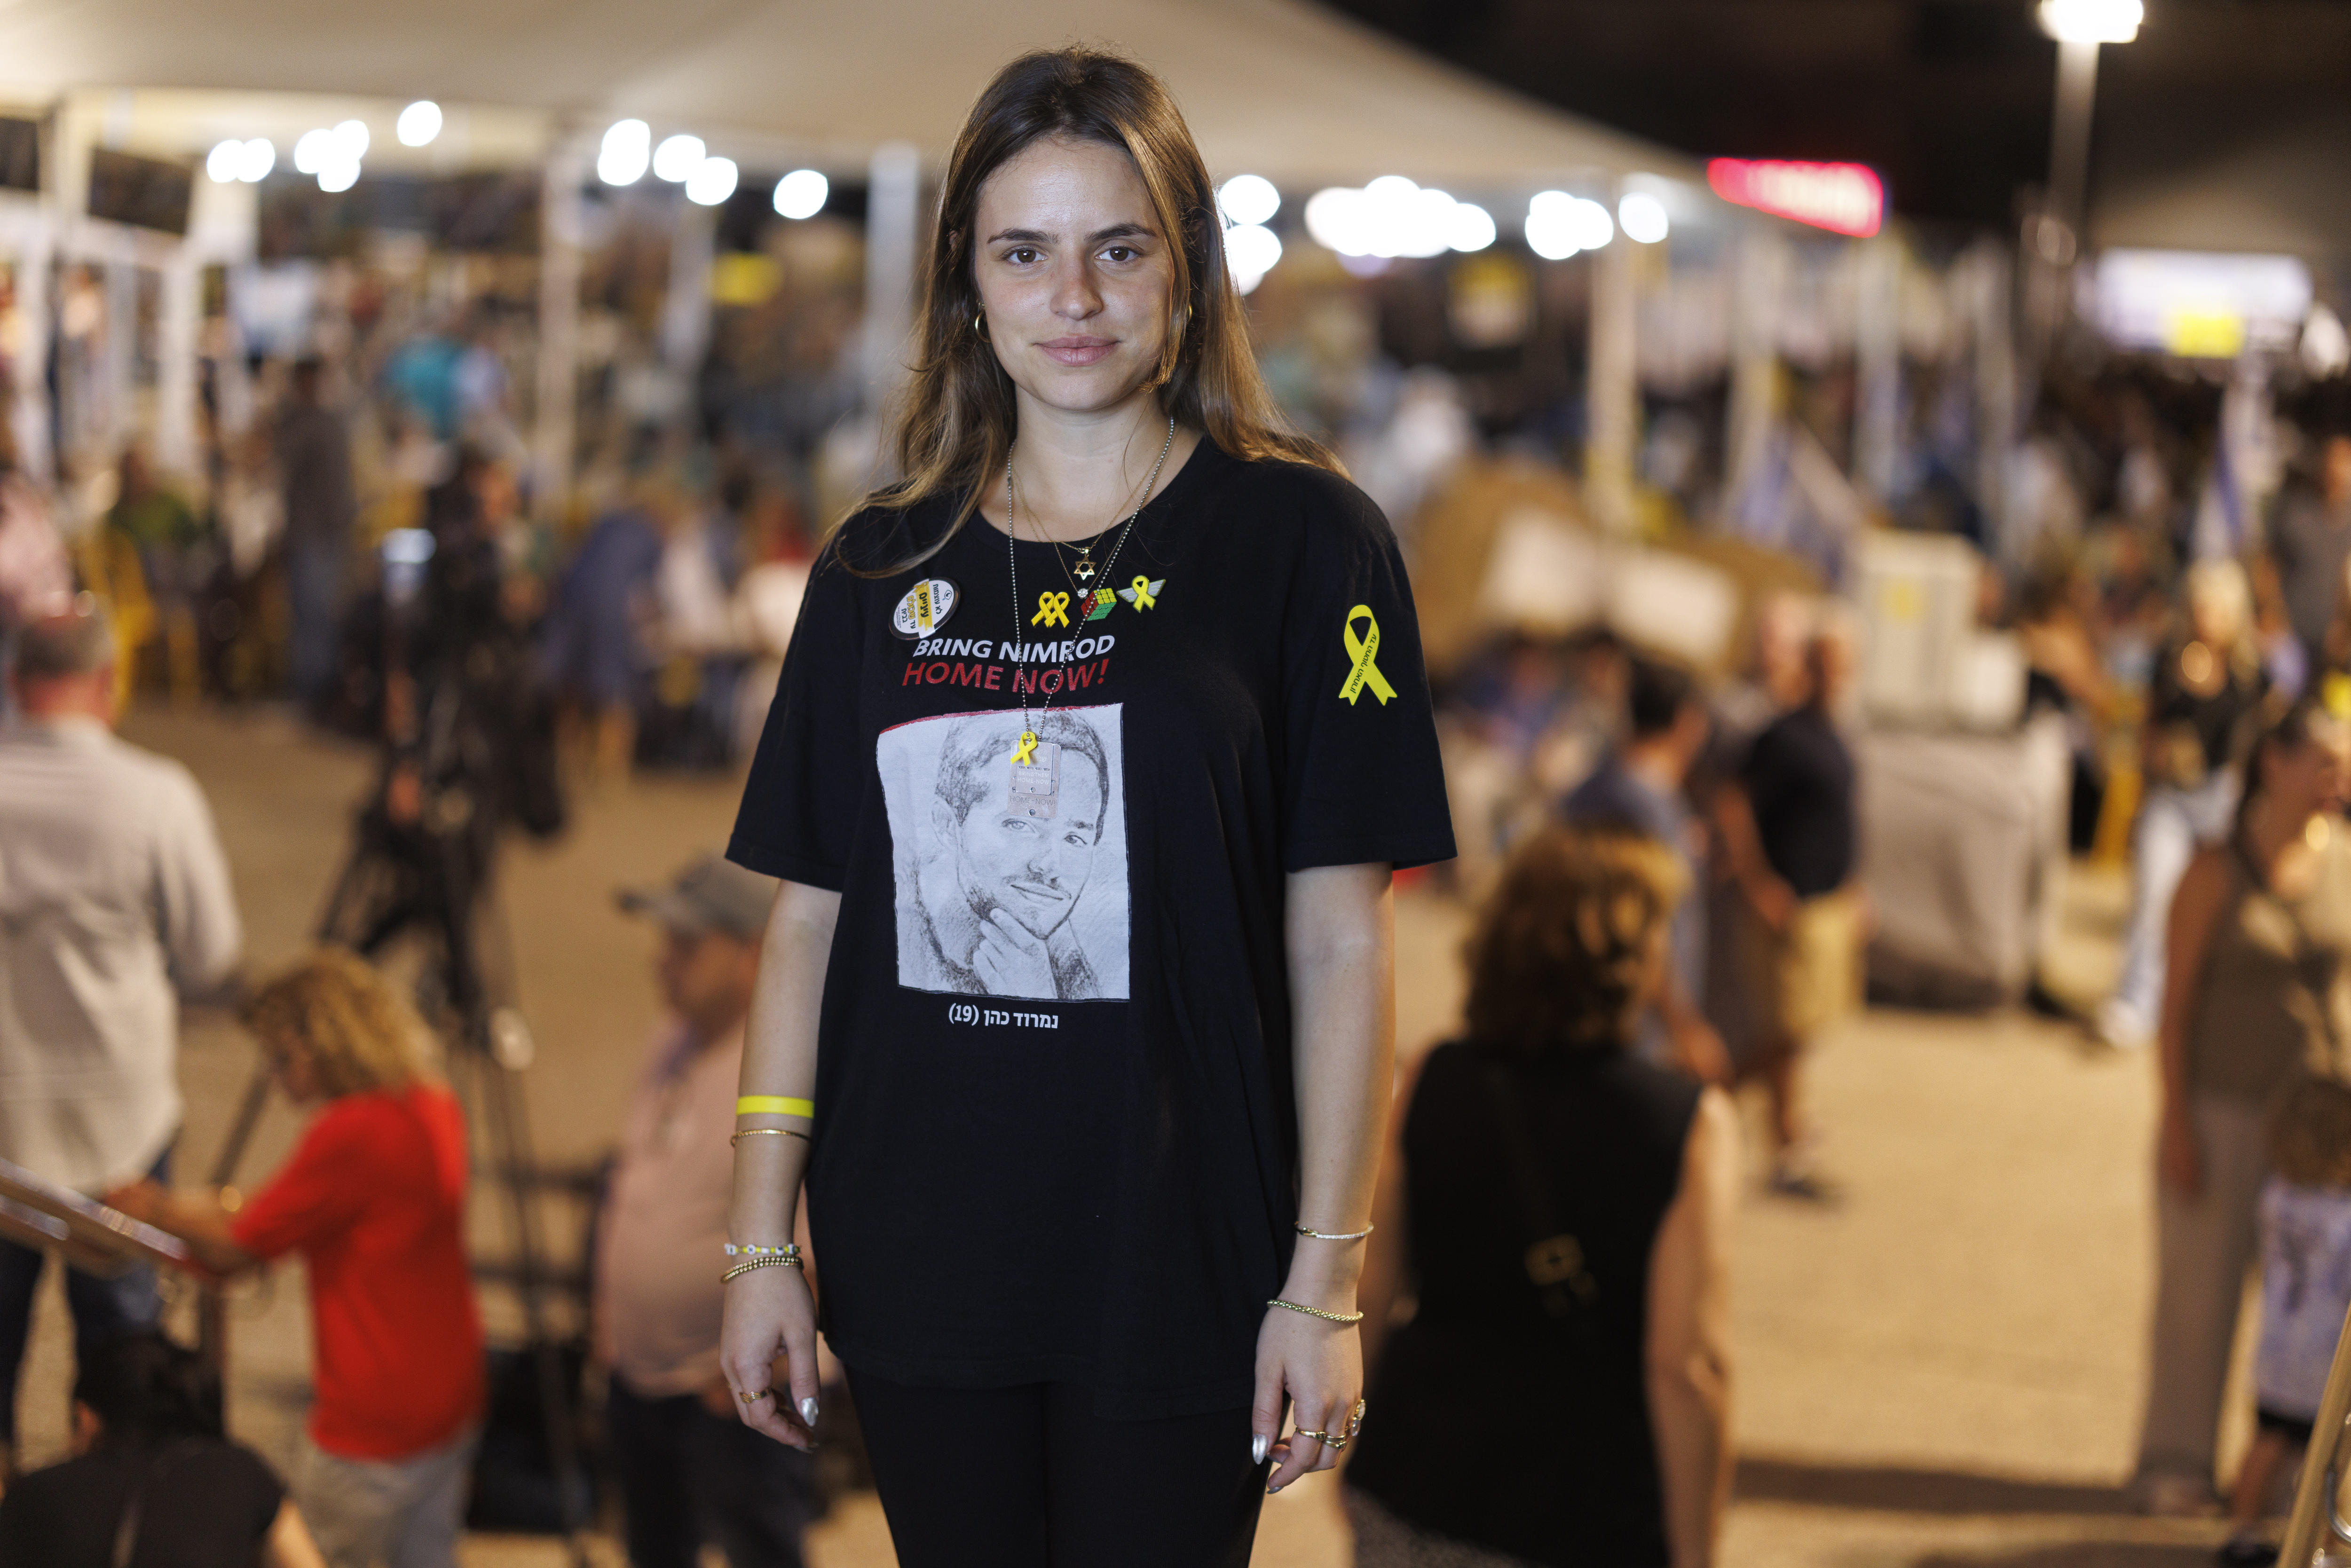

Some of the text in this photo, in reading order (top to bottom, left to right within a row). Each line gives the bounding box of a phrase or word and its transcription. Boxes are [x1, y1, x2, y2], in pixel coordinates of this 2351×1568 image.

[907, 595, 916, 629] עד שכולם
[919, 592, 929, 618] עיניים
[935, 606, 943, 615] לא
[913, 635, 1115, 663] BRING NIMROD
[902, 658, 1110, 694] HOME NOW!
[1350, 634, 1377, 694] עד החטוף האחרון
[949, 1002, 1058, 1029] נמרוד כהן (19)
